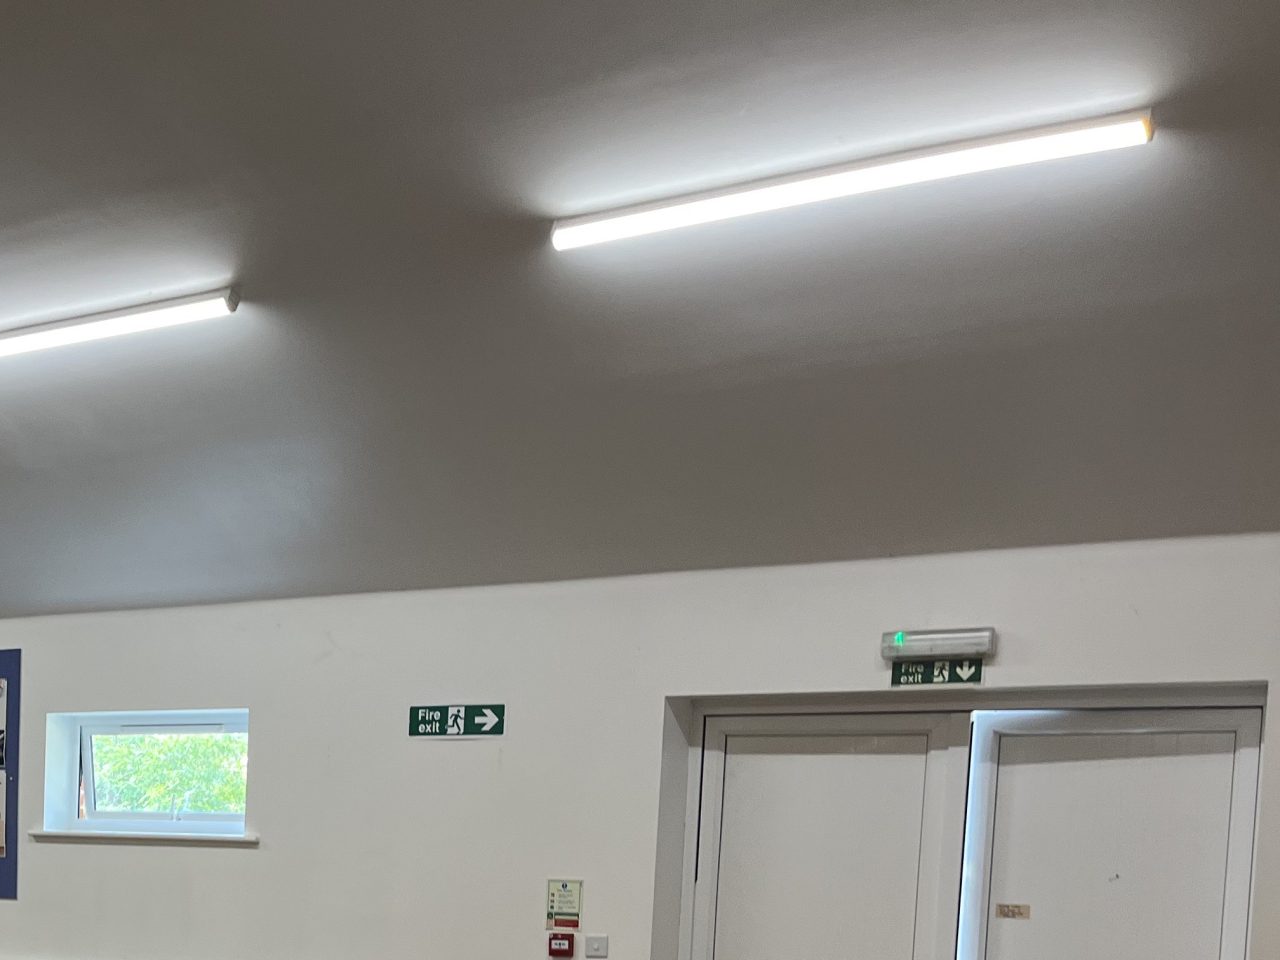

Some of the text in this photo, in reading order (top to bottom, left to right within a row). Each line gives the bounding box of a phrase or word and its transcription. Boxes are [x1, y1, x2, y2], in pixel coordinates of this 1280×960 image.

[901, 662, 925, 673] Fire
[900, 673, 923, 684] exit
[418, 709, 440, 721] Fire
[418, 721, 440, 733] exit
